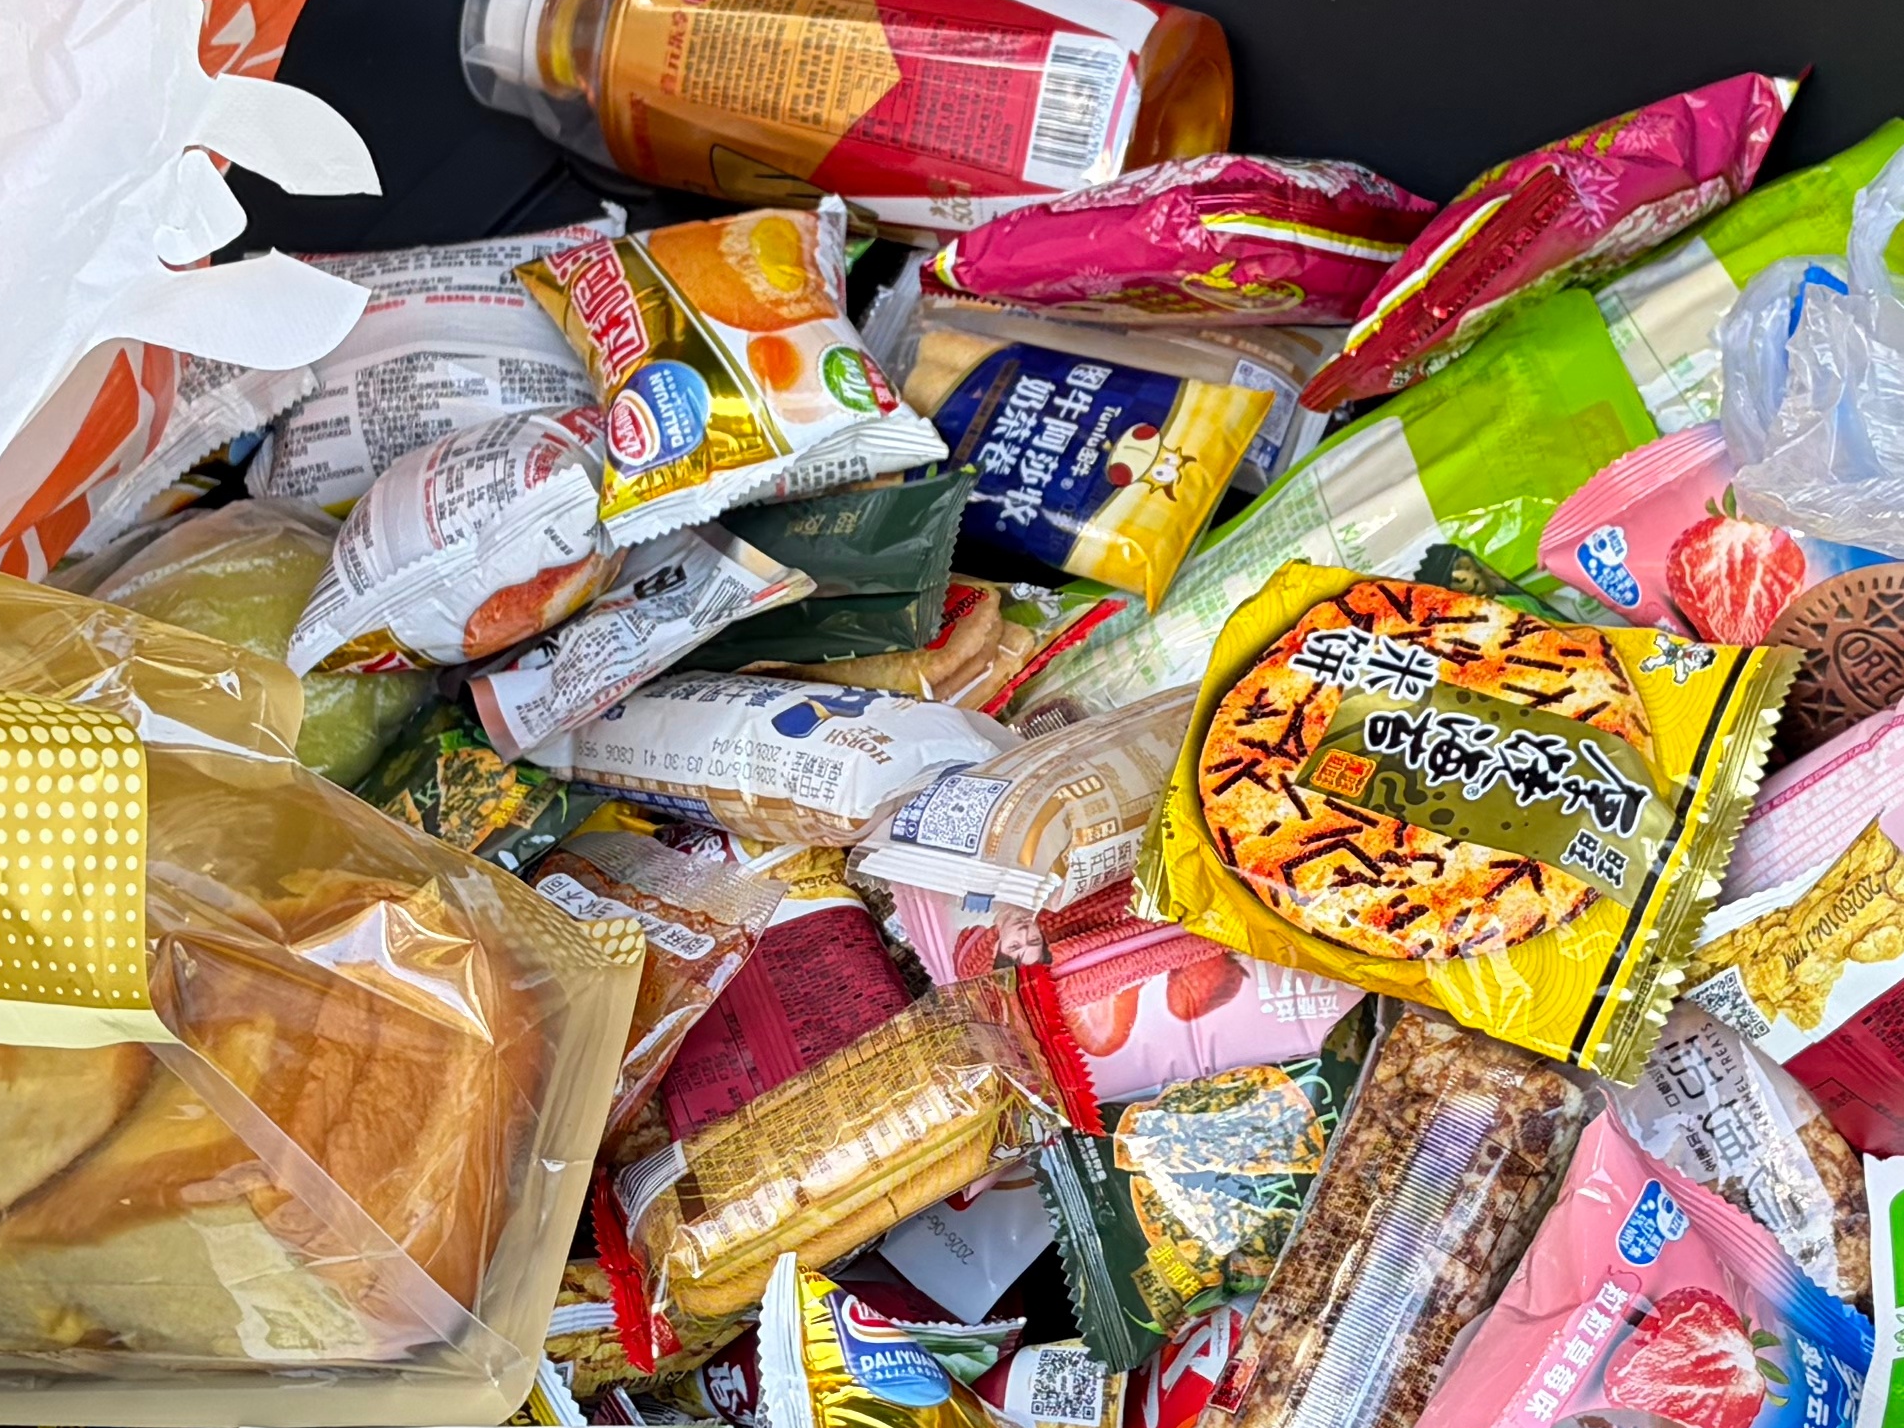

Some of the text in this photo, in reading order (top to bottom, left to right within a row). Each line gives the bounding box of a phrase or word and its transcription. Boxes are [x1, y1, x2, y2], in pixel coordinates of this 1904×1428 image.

[649, 371, 684, 448] DALIYUAN
[1286, 631, 1444, 705] 米饼
[817, 723, 886, 765] HORSH
[1360, 709, 1655, 836] 厚烧海苔
[1566, 827, 1631, 894] 旺旺
[1698, 1020, 1739, 1076] TREATS
[1148, 1241, 1206, 1301] 非油炸
[1521, 1277, 1632, 1426] 粒粒草莓味
